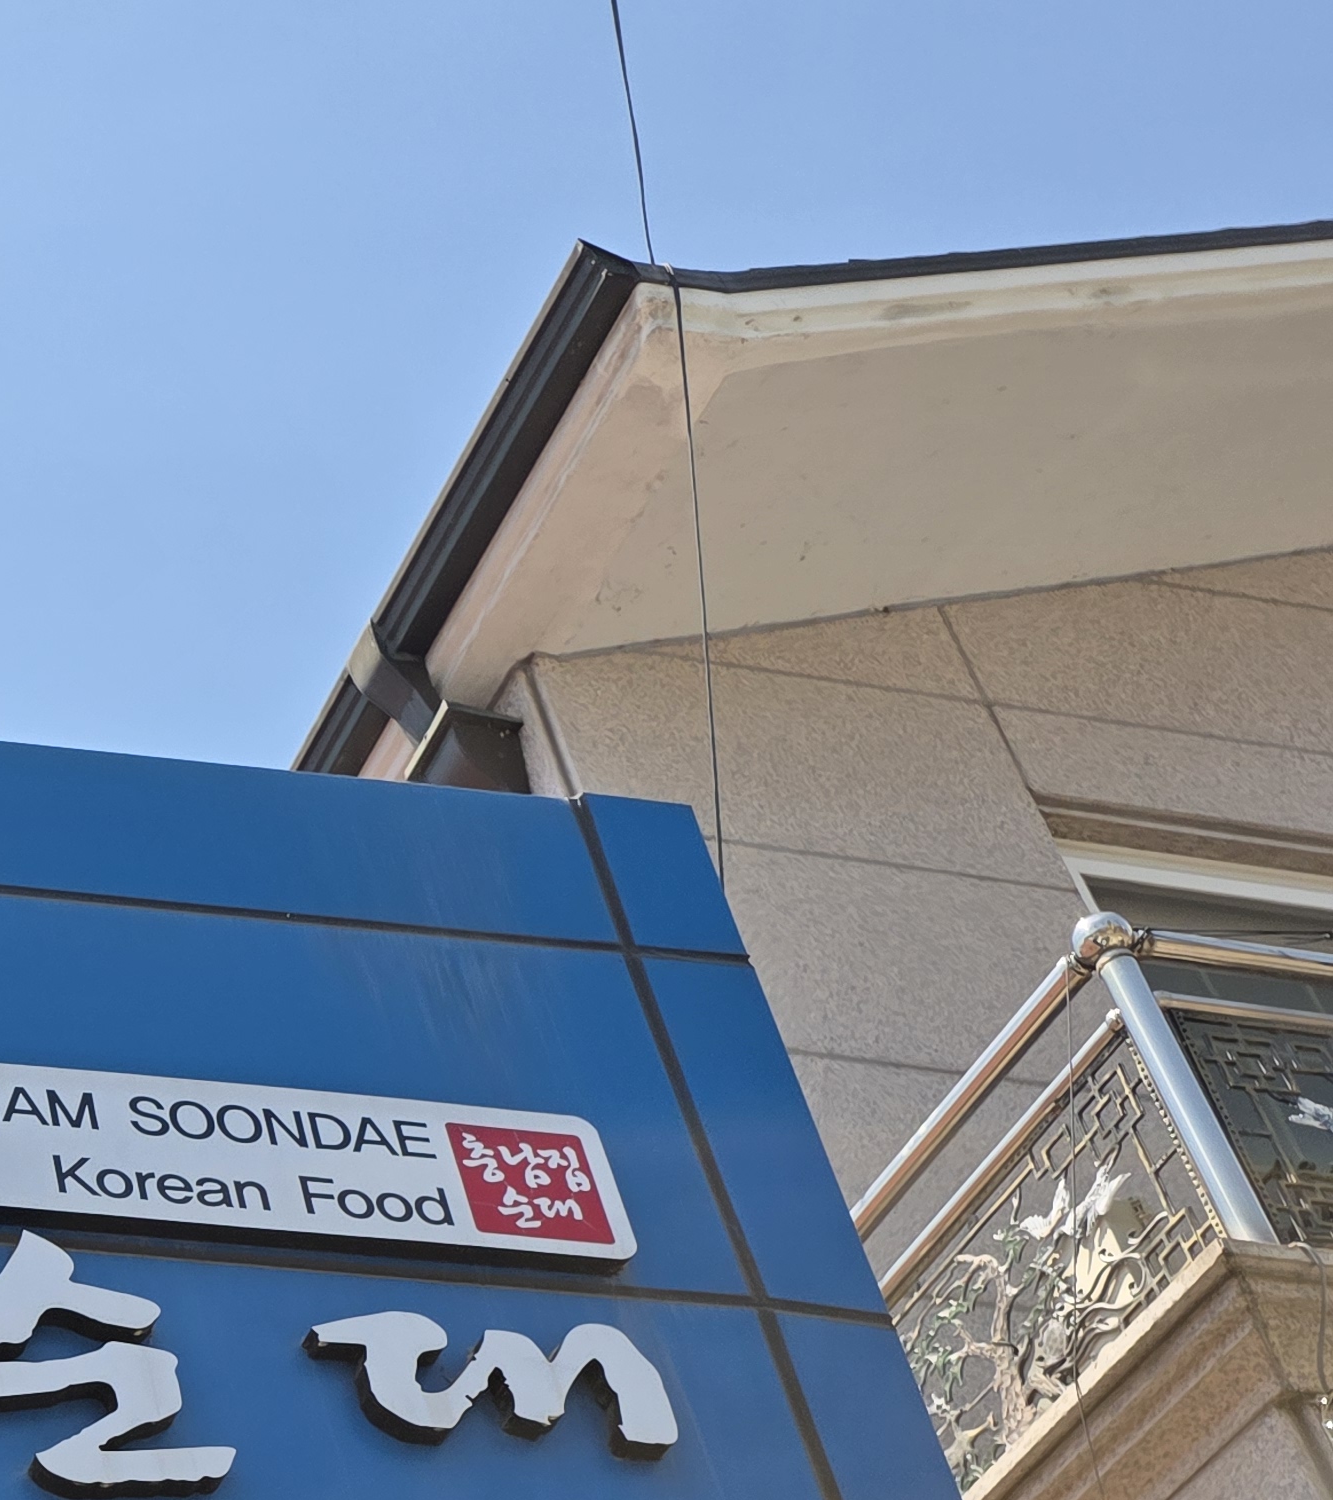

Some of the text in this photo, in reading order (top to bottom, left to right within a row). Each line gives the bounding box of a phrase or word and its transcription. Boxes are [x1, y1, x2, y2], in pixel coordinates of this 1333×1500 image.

[128, 1095, 438, 1160] SOONDAE
[51, 1153, 456, 1228] Korean Food
[461, 1131, 592, 1193] 충남집
[497, 1185, 584, 1229] 순대
